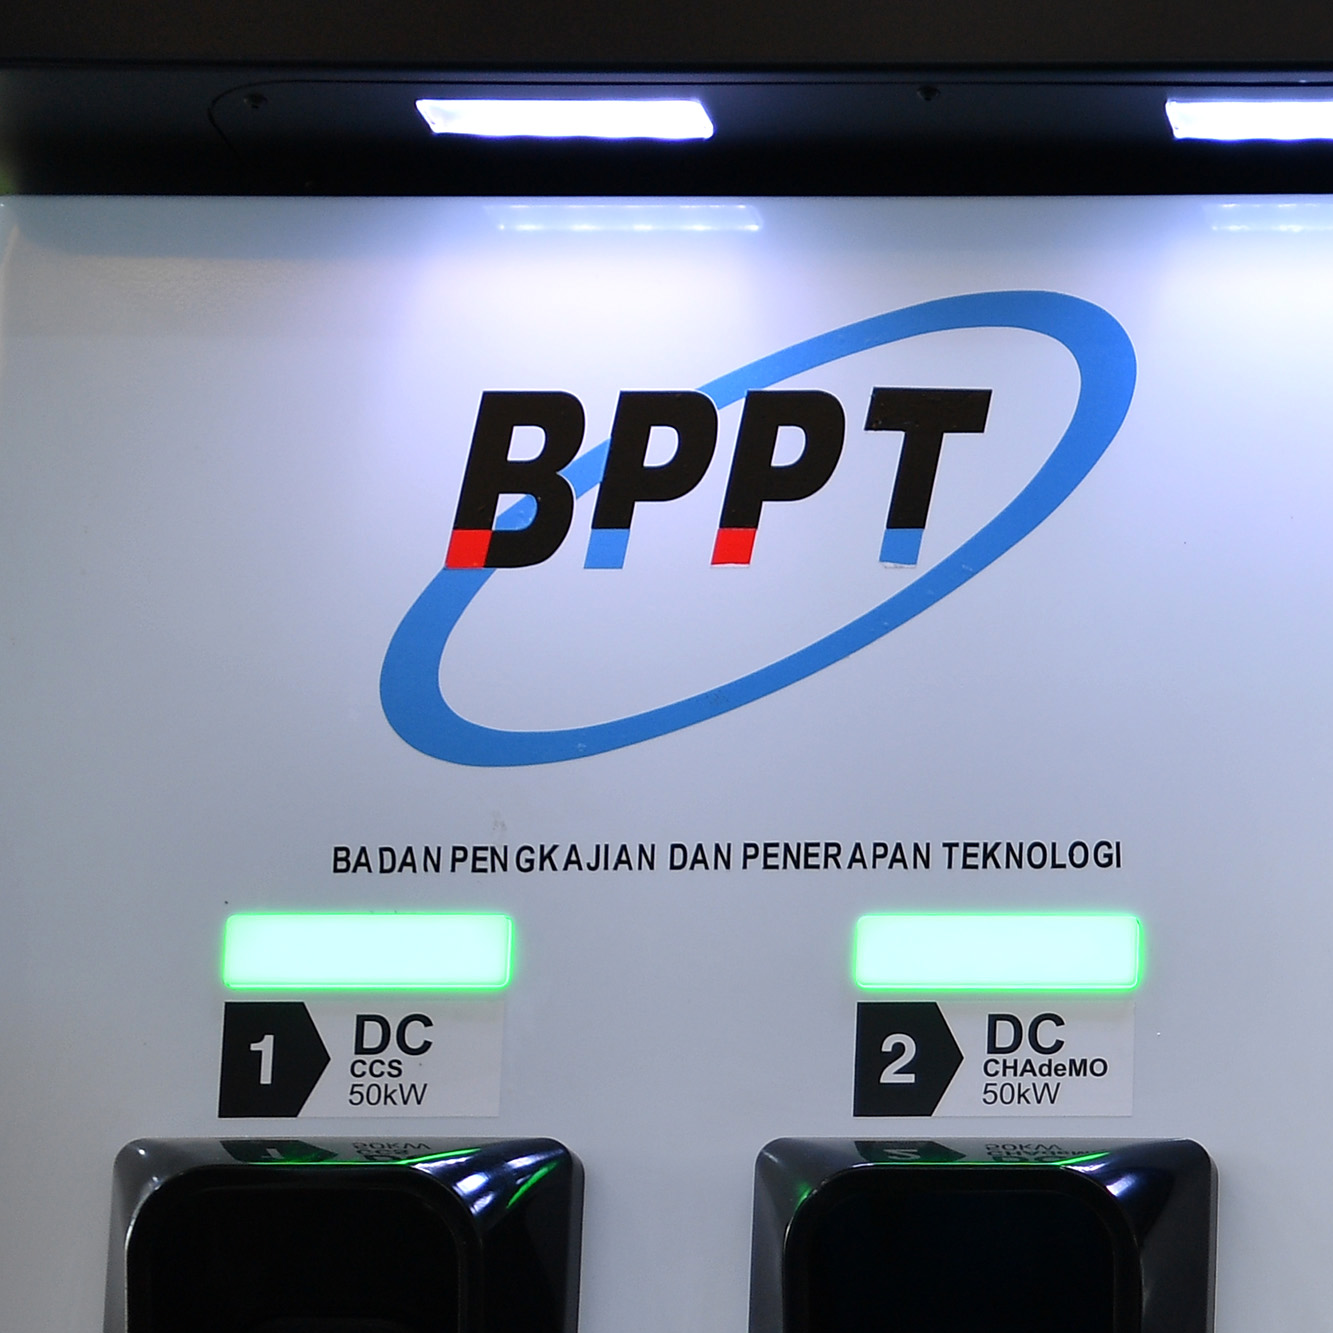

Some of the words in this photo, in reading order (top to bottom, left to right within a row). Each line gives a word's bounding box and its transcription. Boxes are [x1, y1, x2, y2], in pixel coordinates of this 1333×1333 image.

[444, 386, 993, 569] BPPT
[332, 845, 442, 874] BADAN
[450, 843, 656, 874] PENGKAJIAN
[668, 842, 732, 872] DAN
[741, 841, 931, 871] PENERAPAN
[942, 840, 1122, 870] TEKNOLOGI
[353, 1013, 434, 1056] DC
[986, 1012, 1066, 1055] DC
[249, 1034, 275, 1085] 1
[350, 1059, 404, 1079] CCS
[879, 1033, 917, 1084] 2
[982, 1058, 1109, 1078] CHAdeMO
[348, 1083, 428, 1106] 50kW
[981, 1082, 1061, 1105] 50kW
